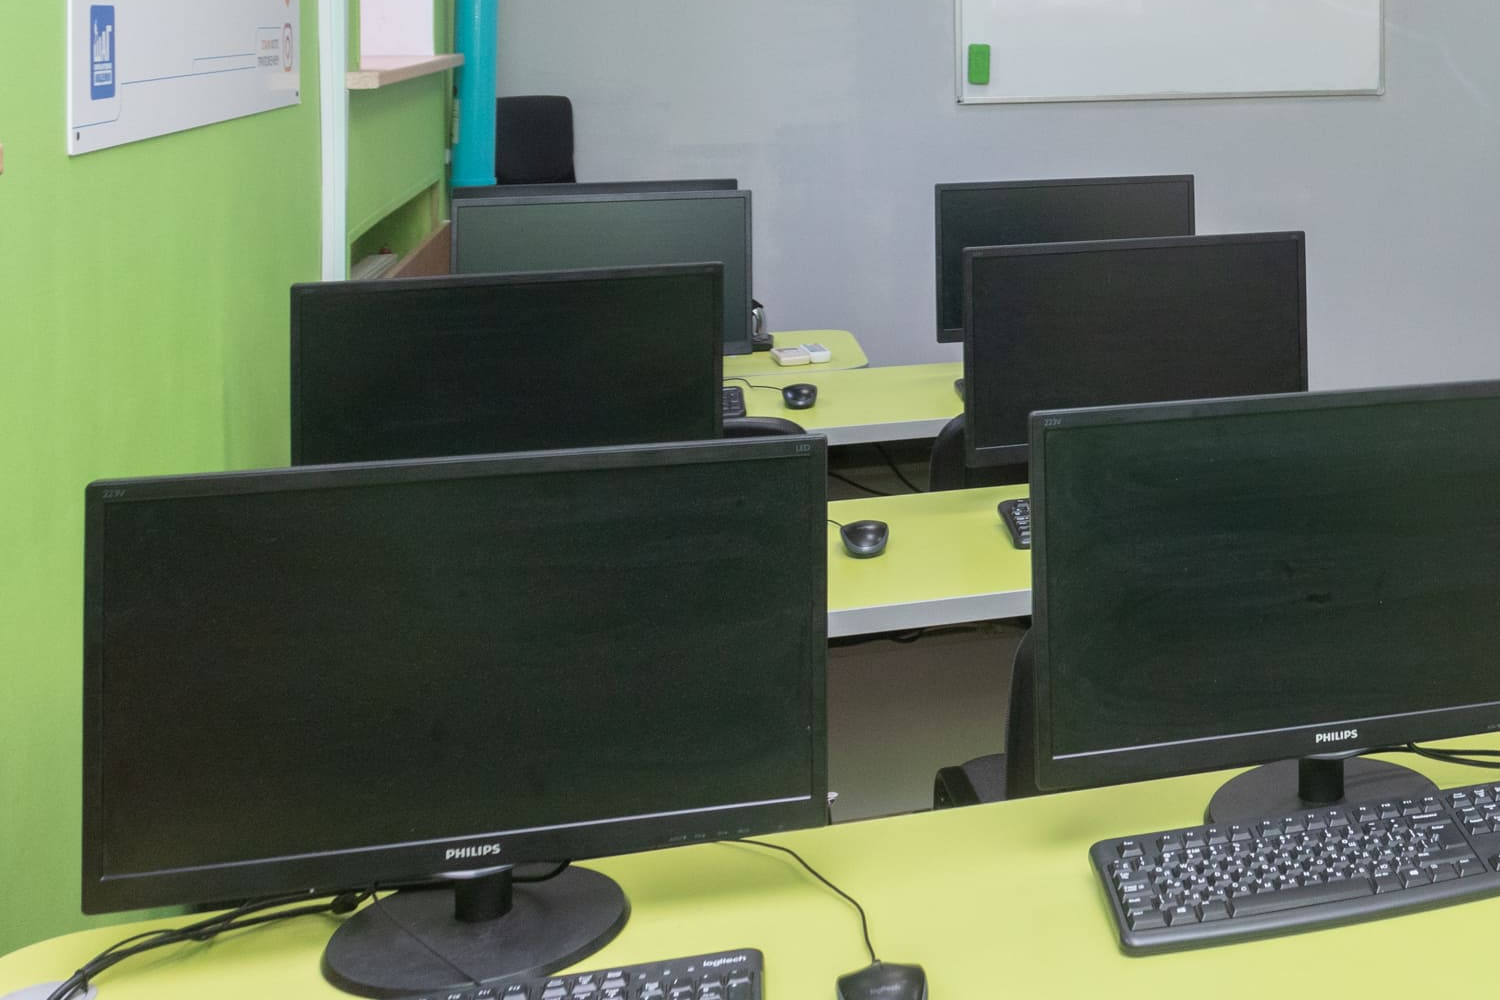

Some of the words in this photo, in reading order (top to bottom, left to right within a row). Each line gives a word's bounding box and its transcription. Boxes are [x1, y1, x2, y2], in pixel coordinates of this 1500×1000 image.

[1315, 729, 1359, 744] PHILIPS
[445, 843, 502, 860] PHILIPS
[703, 955, 747, 967] logitech
